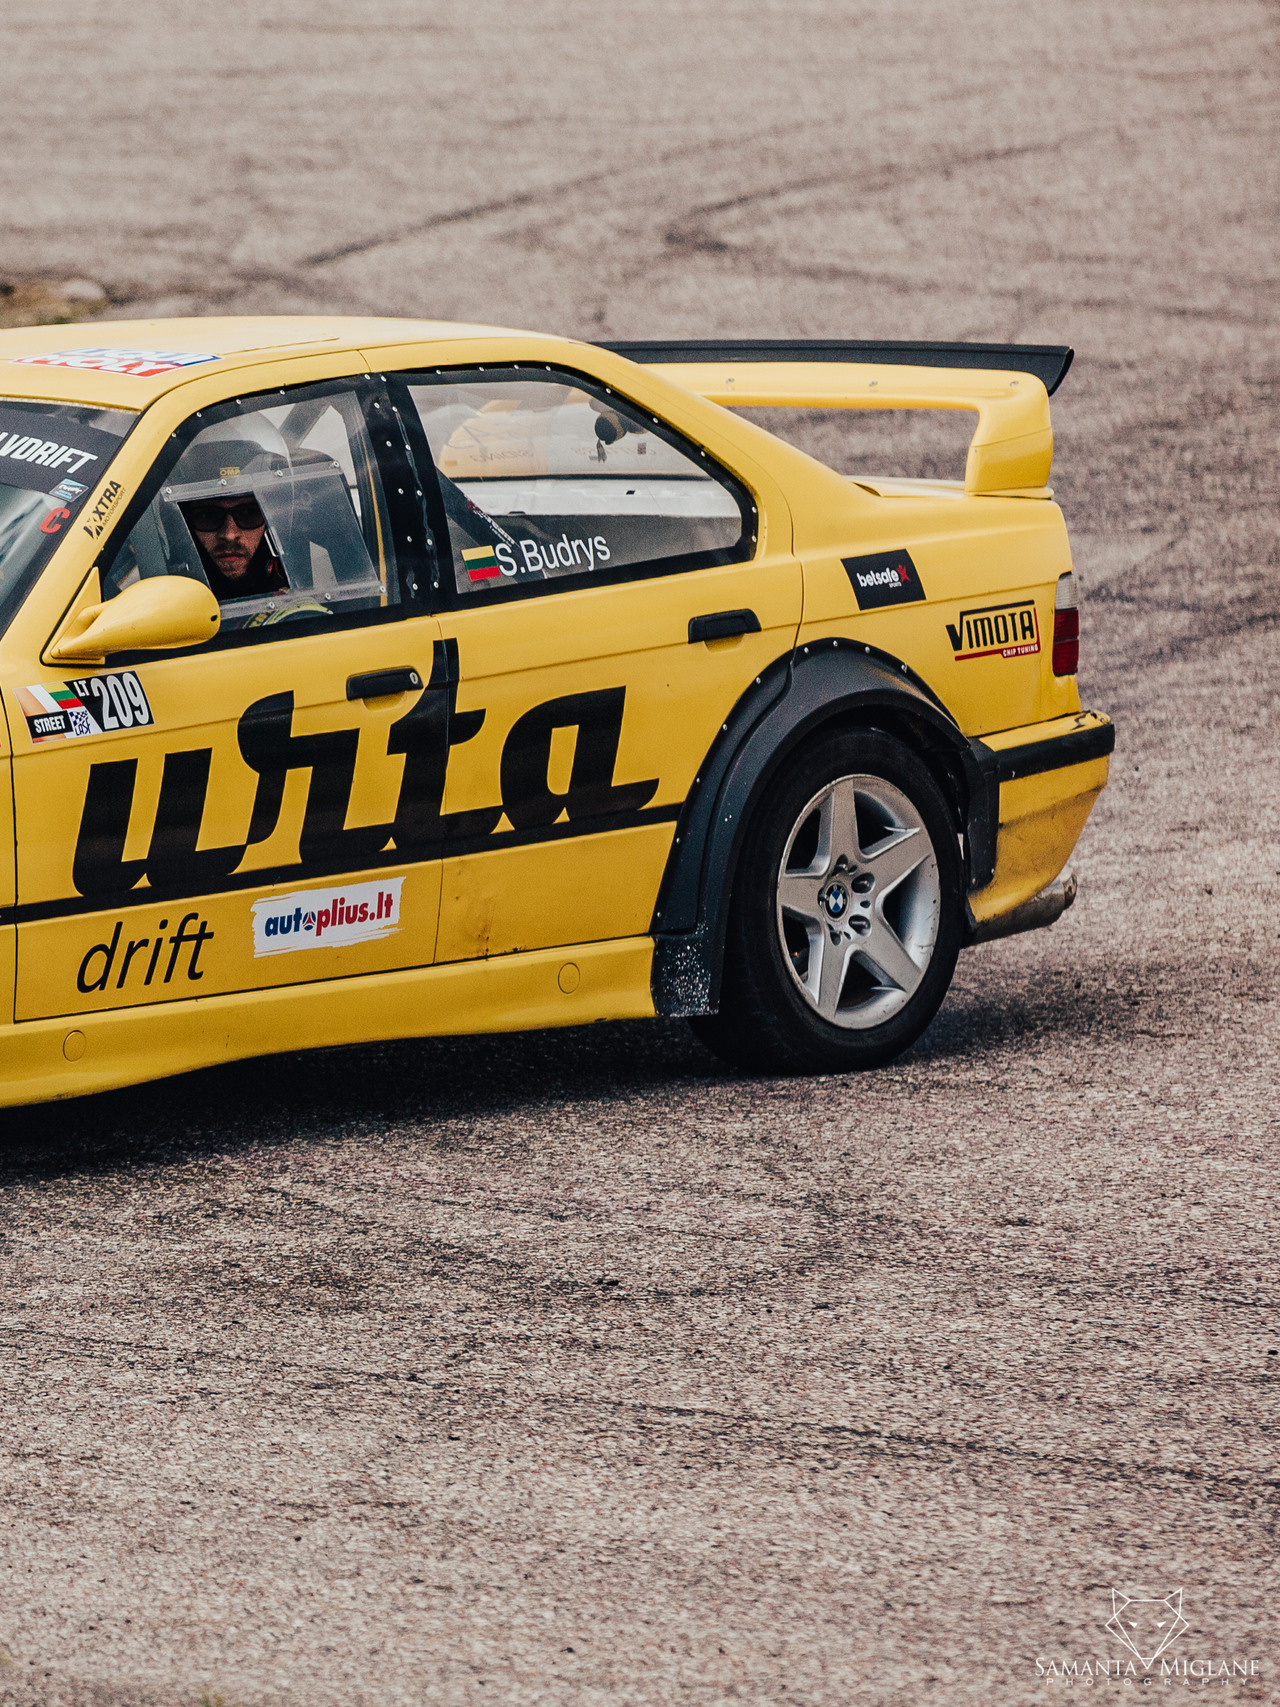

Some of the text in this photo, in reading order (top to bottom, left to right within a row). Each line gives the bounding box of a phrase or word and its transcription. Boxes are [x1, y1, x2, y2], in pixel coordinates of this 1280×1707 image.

[93, 480, 122, 521] XTRA
[495, 534, 611, 577] S.Budrys
[856, 567, 900, 588] betsafe
[73, 673, 150, 730] LT 209
[33, 714, 66, 734] STREET
[76, 911, 214, 994] drift
